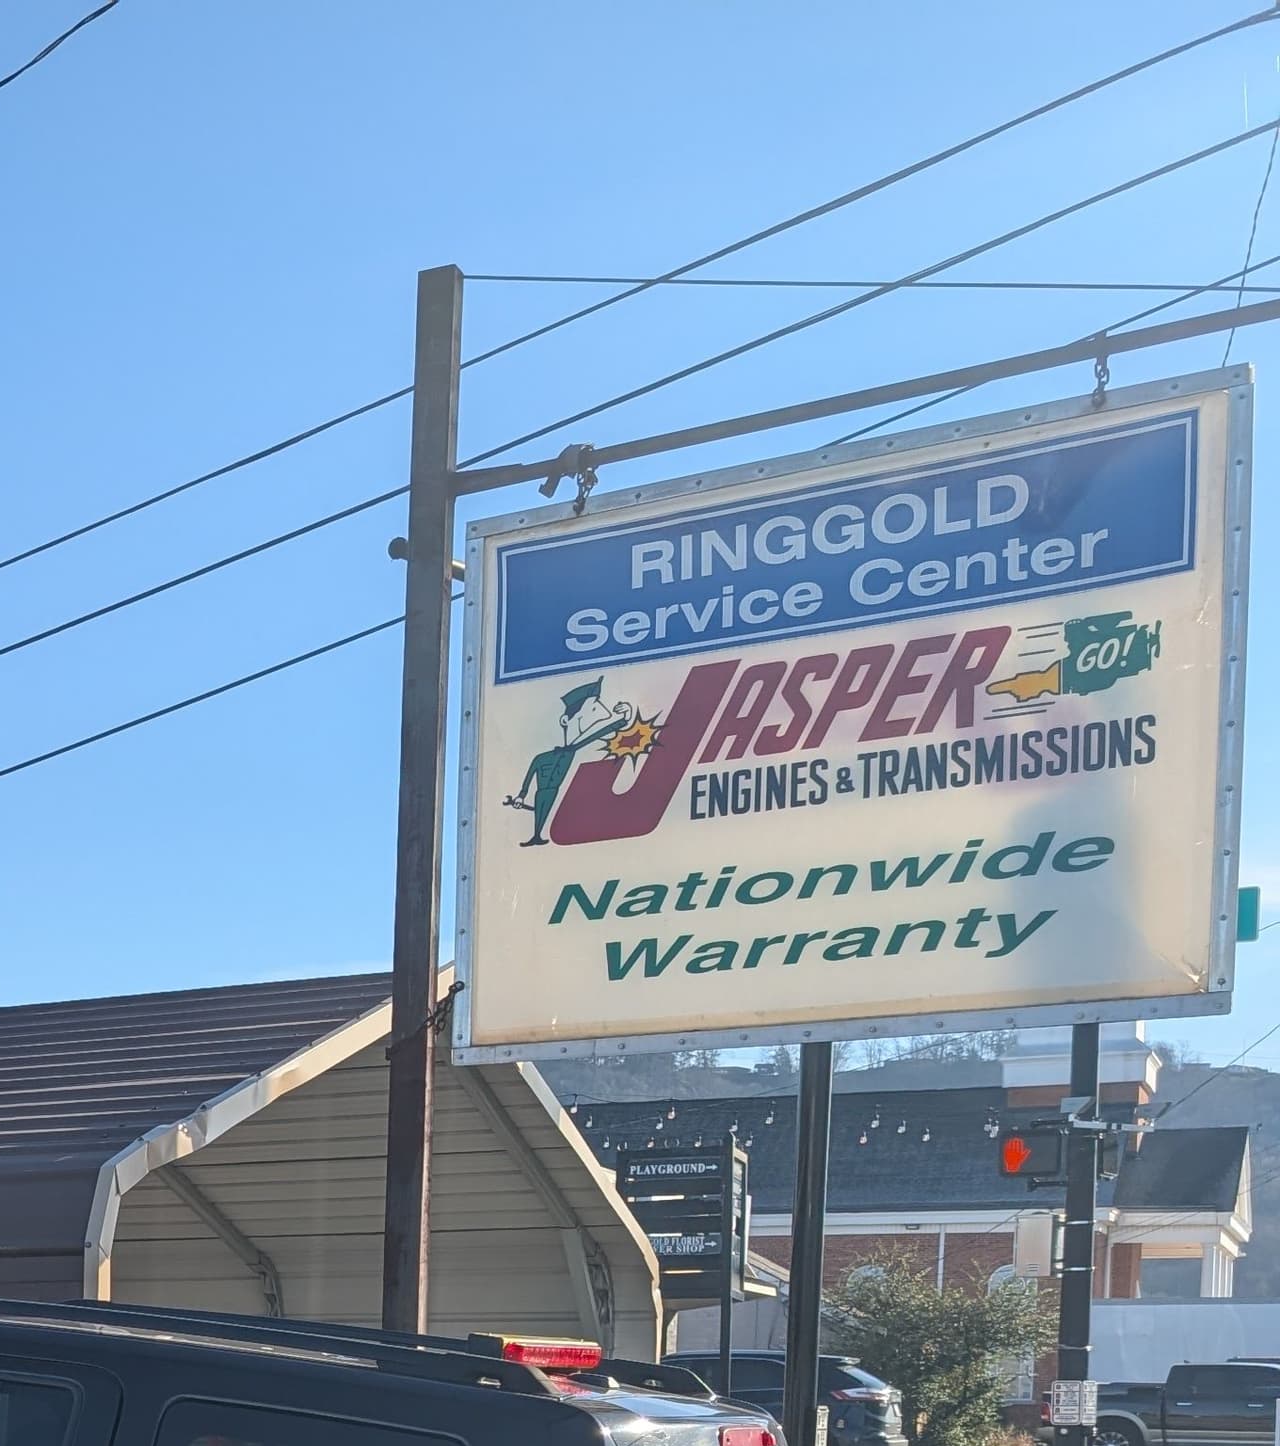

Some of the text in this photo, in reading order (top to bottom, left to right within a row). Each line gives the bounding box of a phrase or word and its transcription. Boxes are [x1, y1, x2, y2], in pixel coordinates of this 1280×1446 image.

[630, 473, 1031, 589] RINGGOLD
[565, 527, 1110, 652] Service Center
[1076, 631, 1138, 674] GO!
[549, 625, 1013, 847] JASPER
[689, 714, 1157, 821] ENGINES & TRANSMISSIONS
[547, 830, 1116, 925] Nationwide
[603, 906, 1059, 981] Warranty
[629, 1162, 706, 1176] PLAYGROUND
[671, 1235, 705, 1247] FLORIST
[676, 1244, 705, 1254] SHOP
